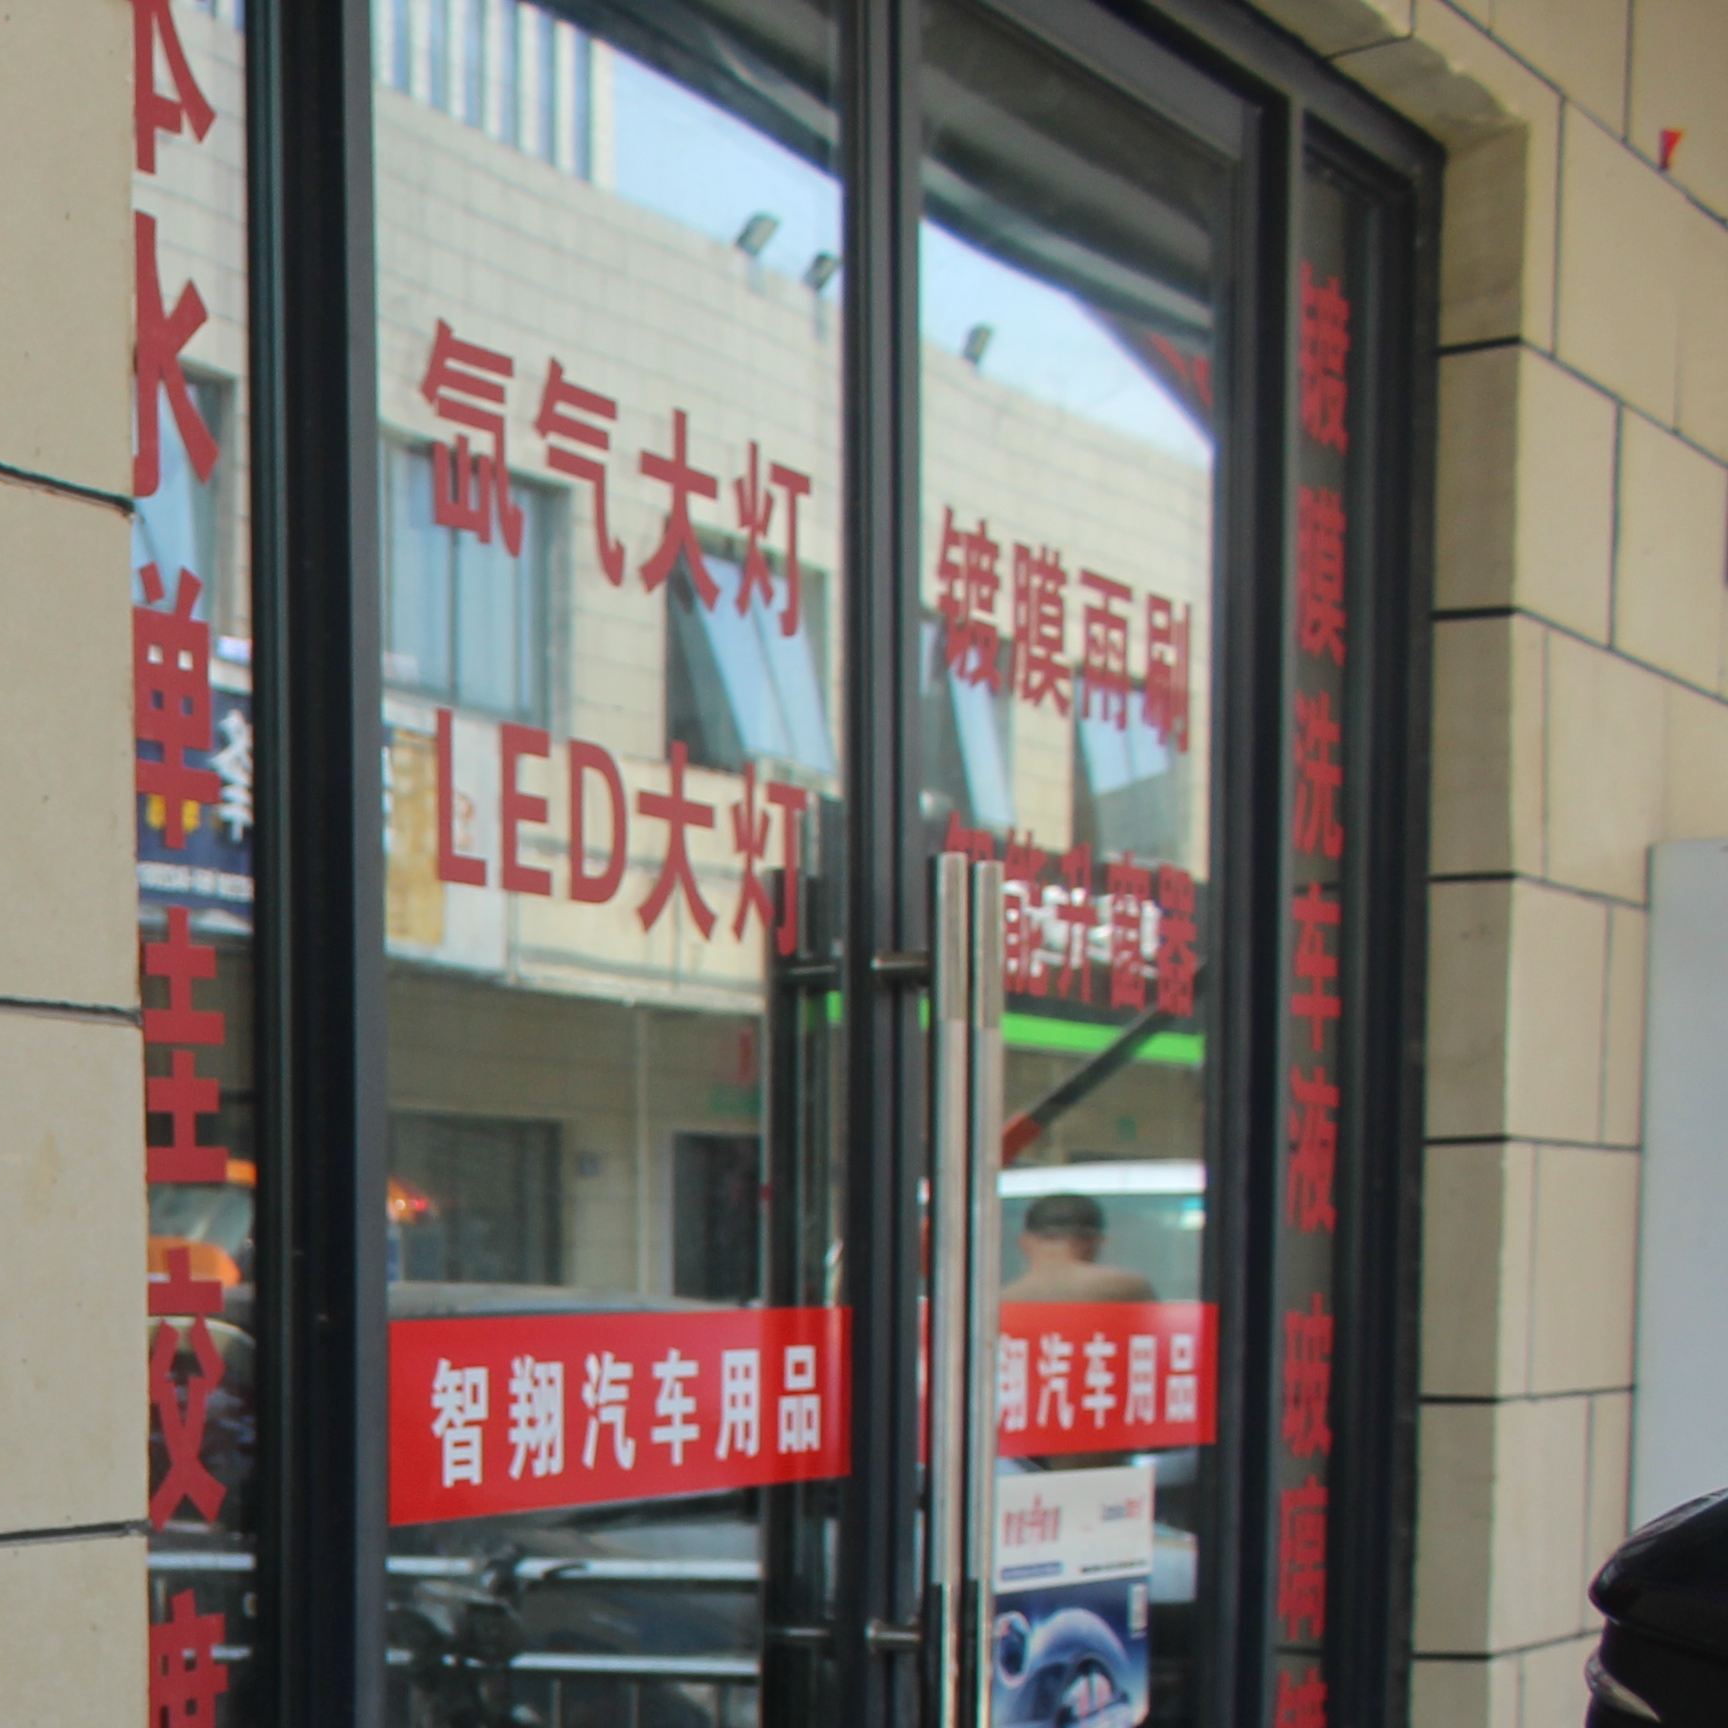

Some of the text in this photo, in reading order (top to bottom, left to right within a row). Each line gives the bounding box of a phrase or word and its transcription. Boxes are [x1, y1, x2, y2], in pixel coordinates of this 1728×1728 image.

[420, 319, 812, 640] 氙气大灯
[436, 707, 809, 956] LED大灯
[430, 1343, 823, 1488] 智翔汽车用品
